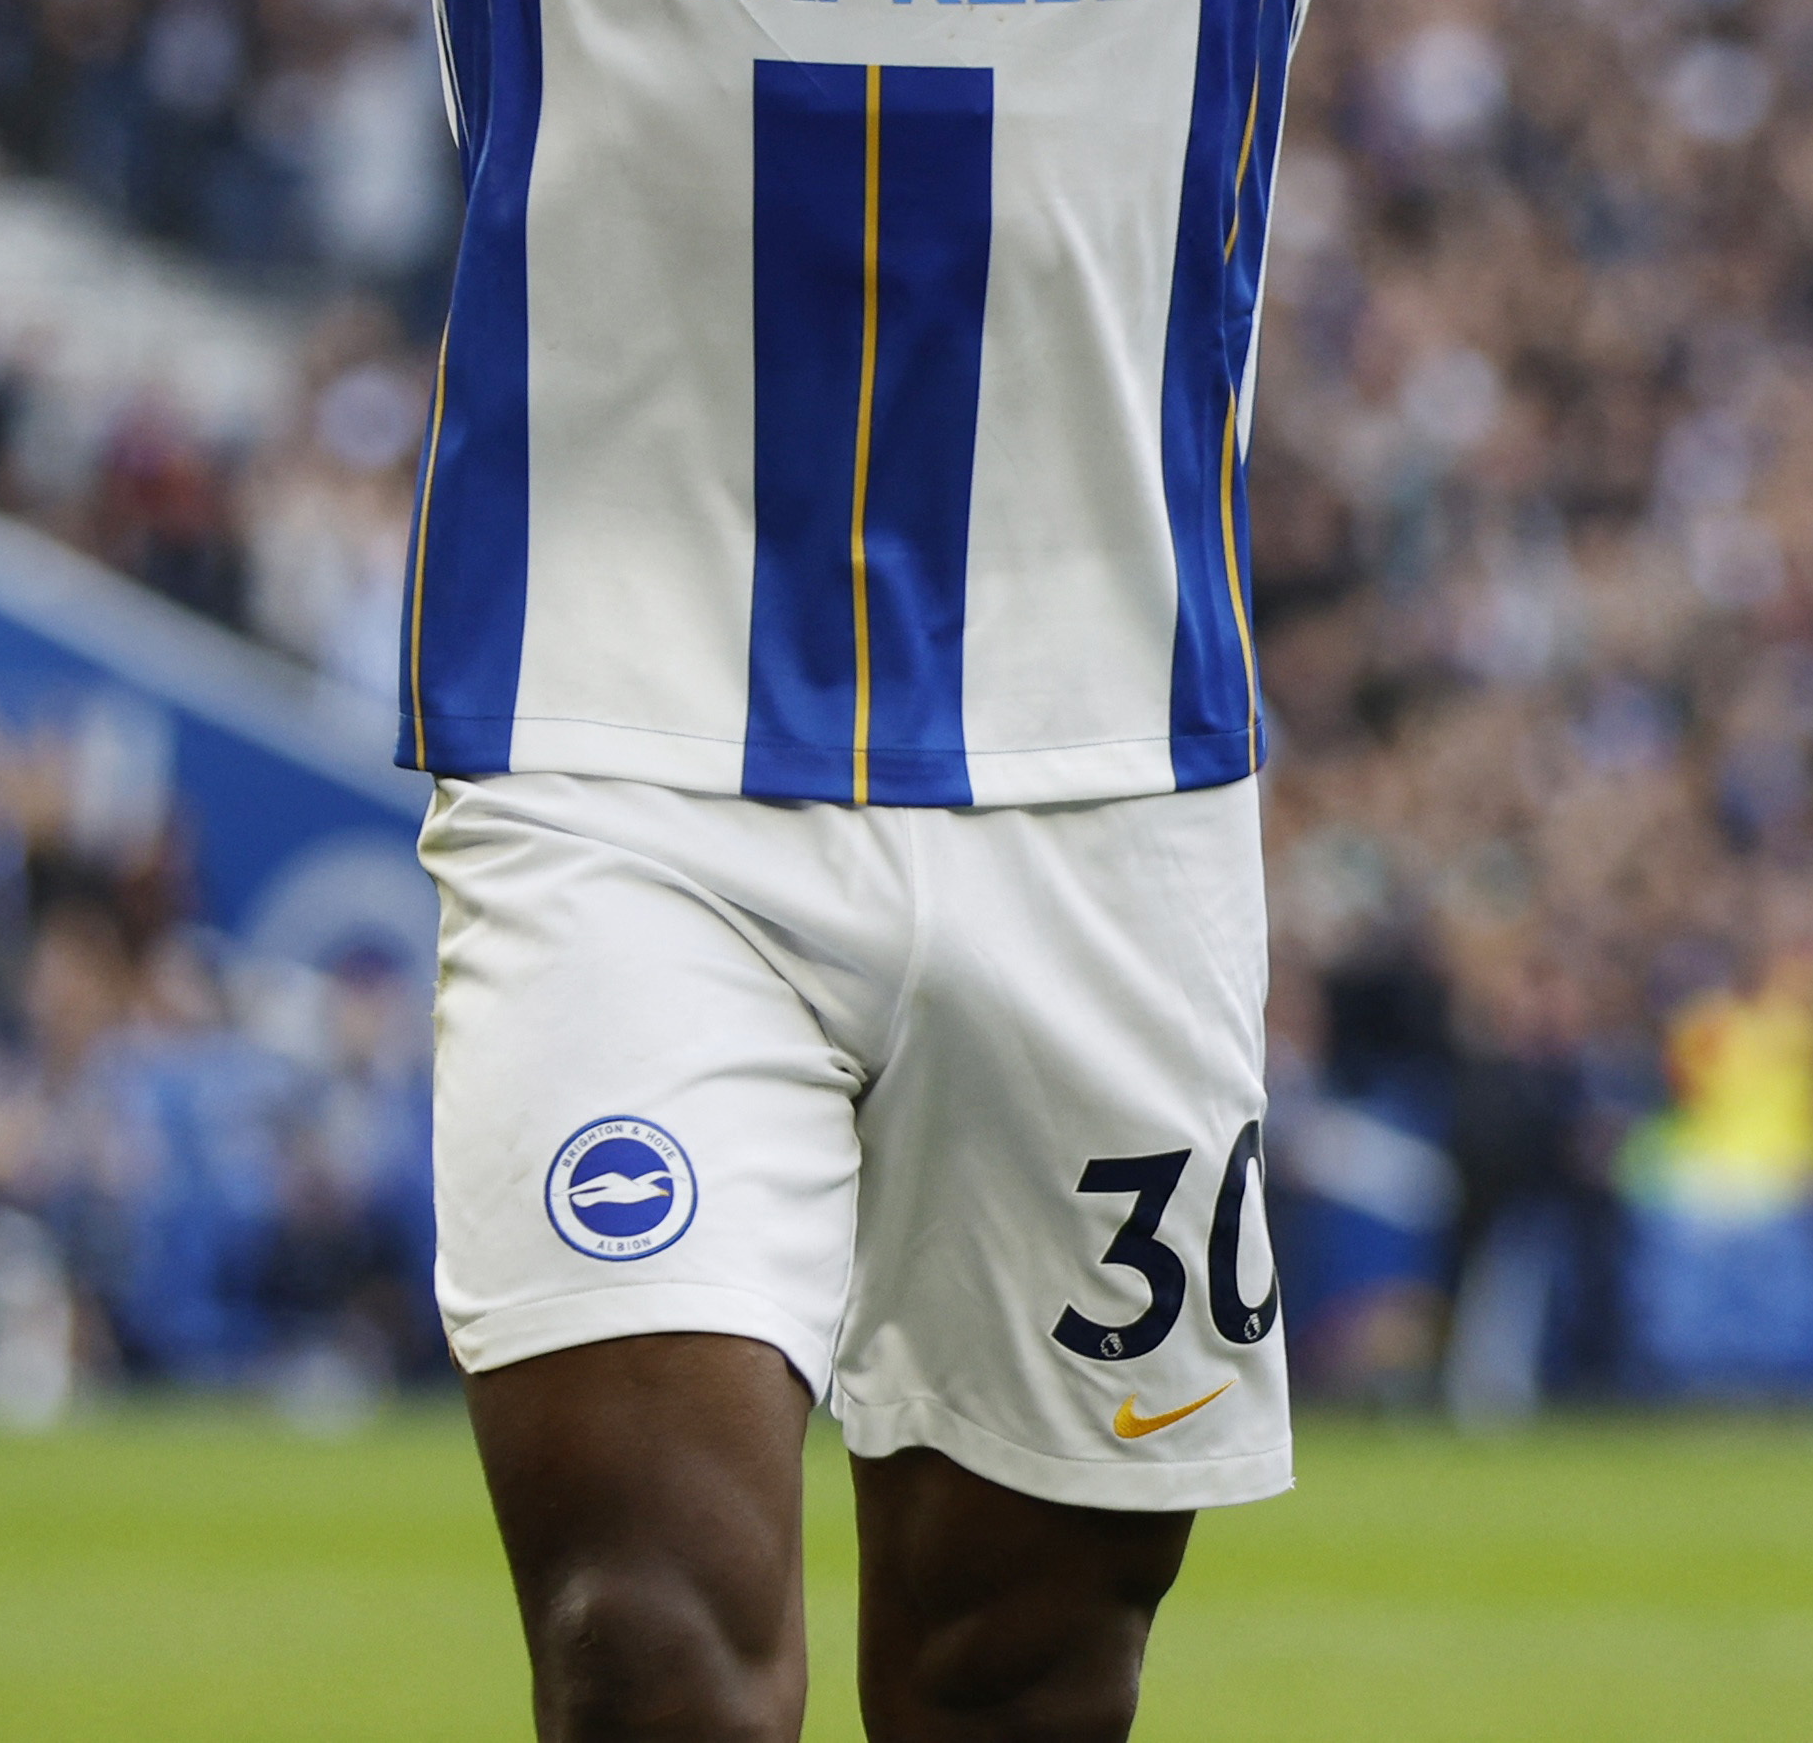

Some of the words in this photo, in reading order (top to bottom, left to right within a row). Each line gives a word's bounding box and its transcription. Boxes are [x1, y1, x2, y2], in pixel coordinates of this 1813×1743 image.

[561, 1124, 624, 1169] BRIGHTON
[645, 1131, 677, 1160] HOVE
[596, 1236, 652, 1252] ALBION
[1050, 1119, 1279, 1362] 30
